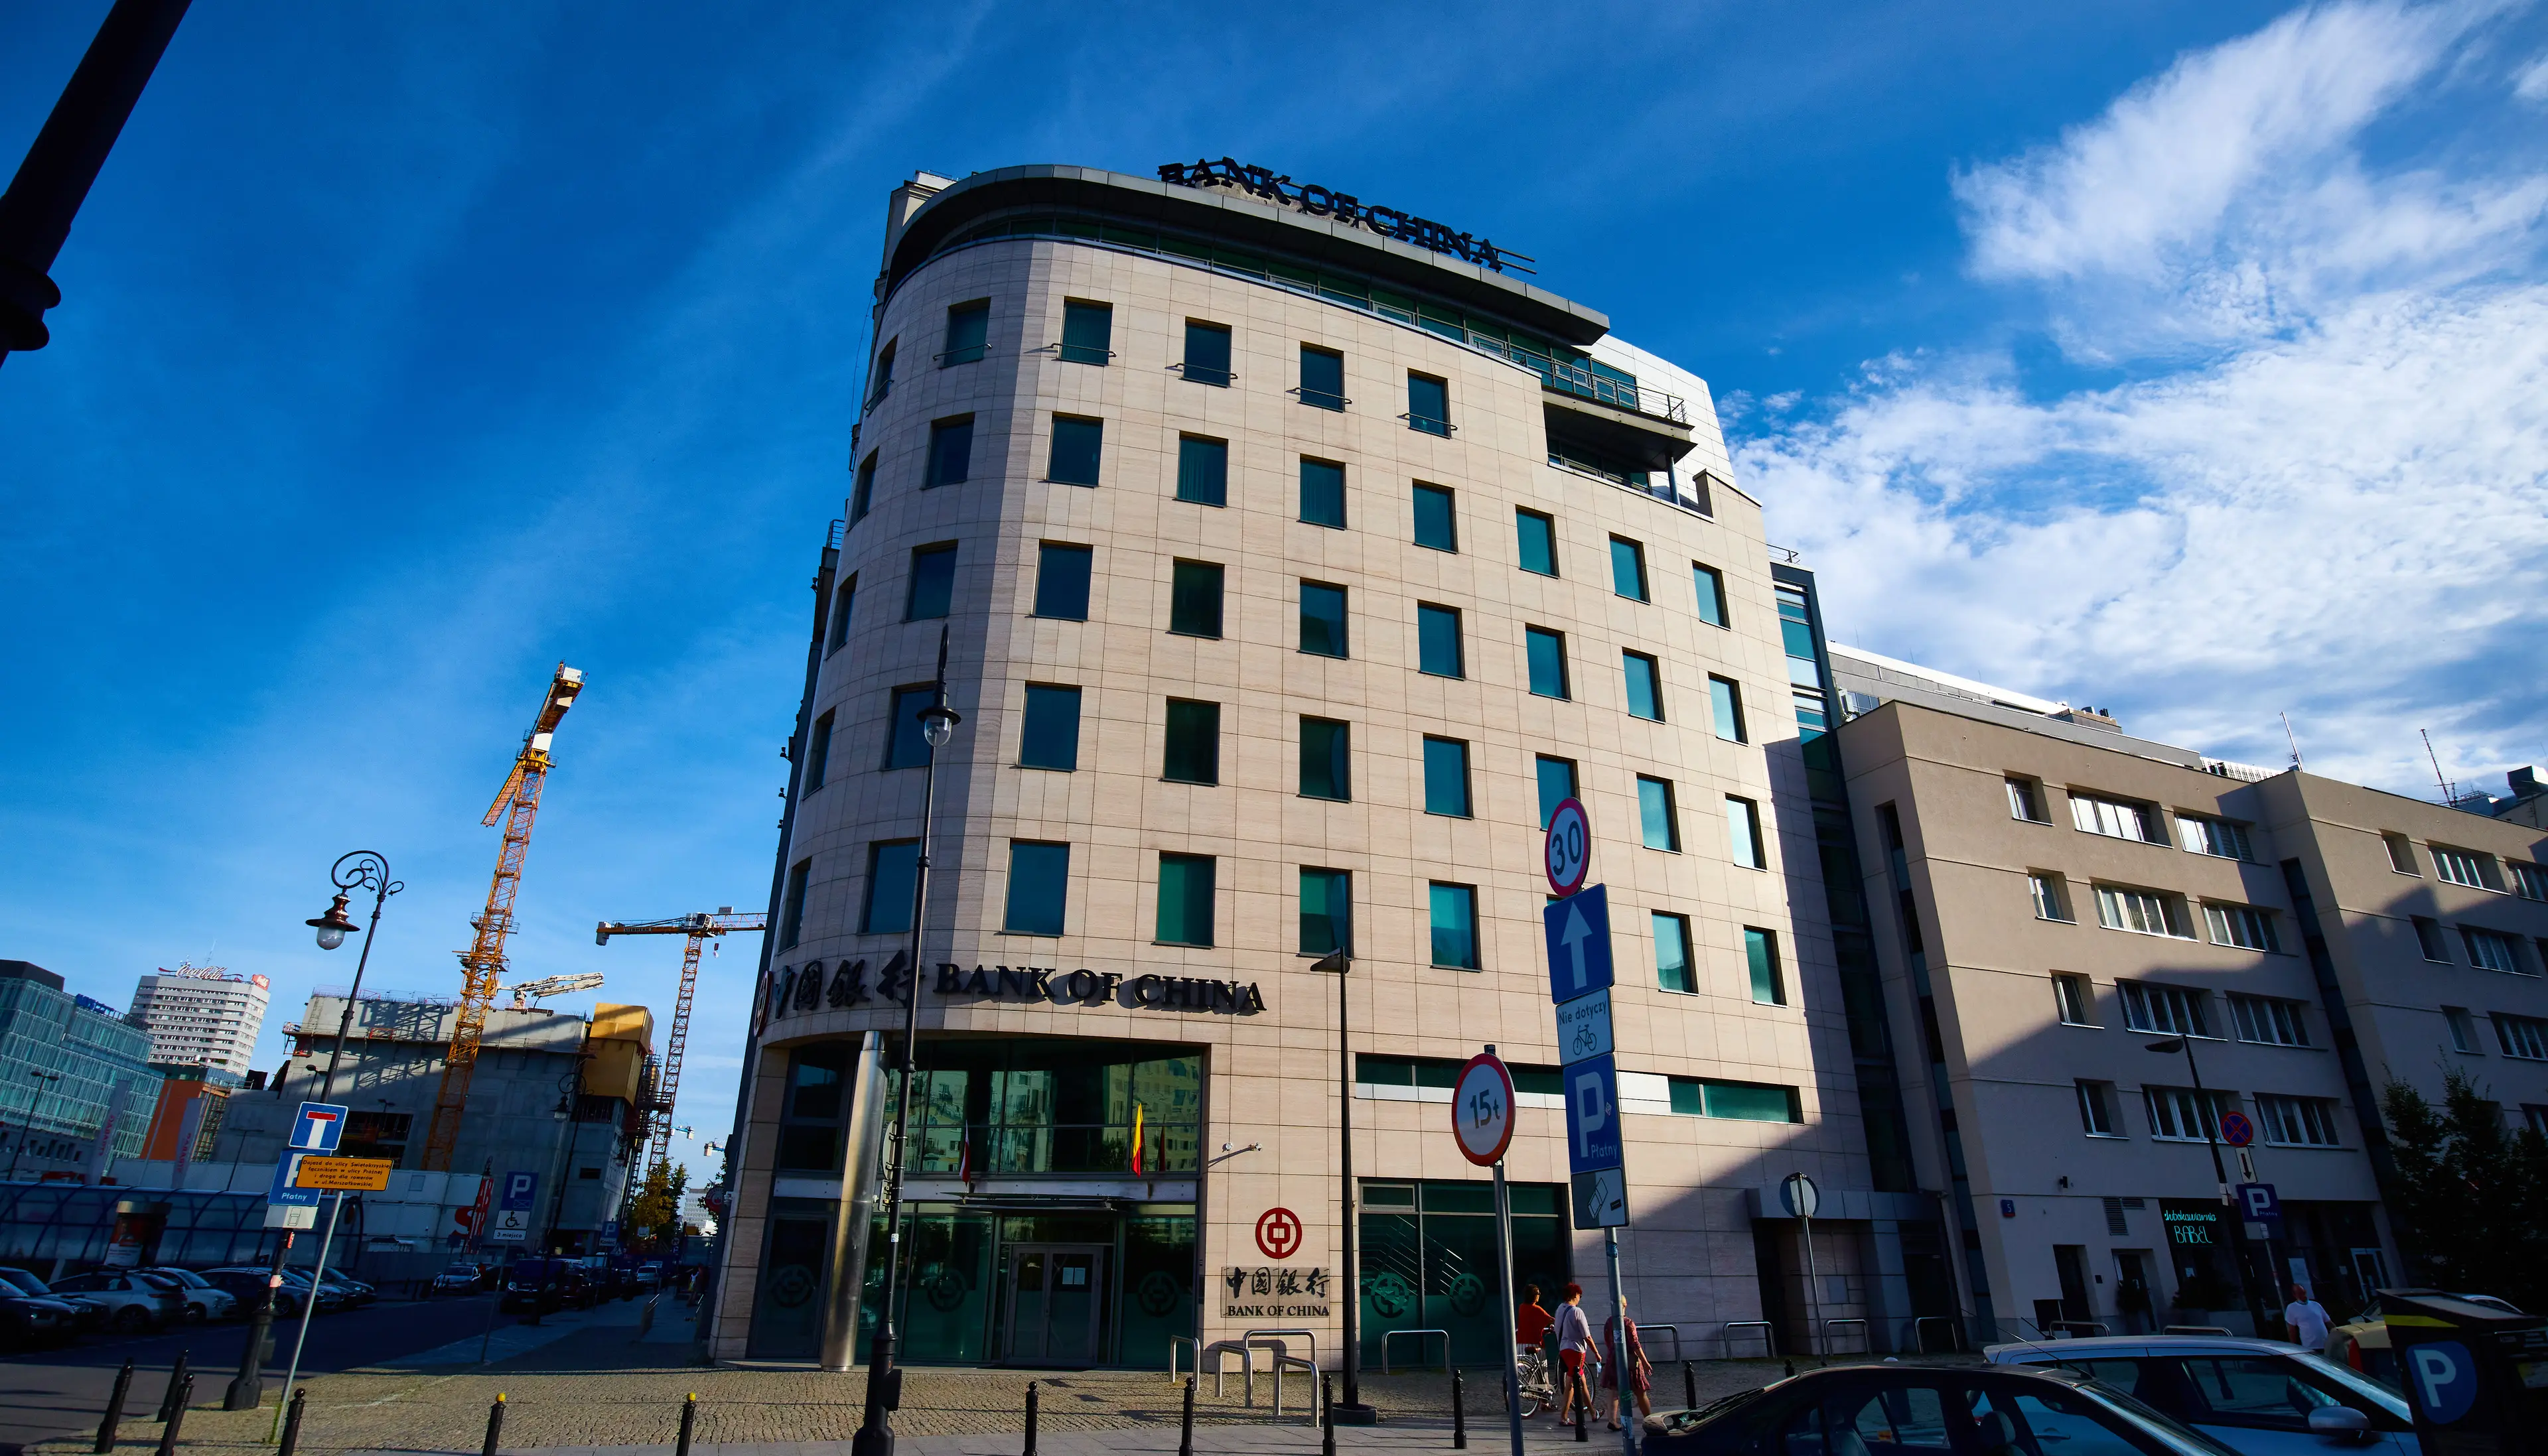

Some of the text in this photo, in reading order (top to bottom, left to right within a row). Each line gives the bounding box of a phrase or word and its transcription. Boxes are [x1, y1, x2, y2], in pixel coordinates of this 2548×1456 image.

[1157, 156, 1502, 271] BANK OF CHINA
[1551, 820, 1582, 876] 30
[933, 963, 1267, 1012] BANK OF CHINA
[1558, 1000, 1608, 1025] Nie dotyczy
[1575, 1071, 1605, 1159] P
[1591, 1144, 1618, 1159] Płatny
[281, 1193, 307, 1202] Płatny
[510, 1175, 531, 1199] P
[2007, 1203, 2012, 1213] 5
[2246, 1188, 2271, 1217] P
[605, 1223, 616, 1236] P
[2174, 1226, 2212, 1244] BABEL
[1226, 1266, 1330, 1299] 中國銀行
[1227, 1305, 1330, 1316] BANK OF CHINA
[2413, 1349, 2456, 1407] P
